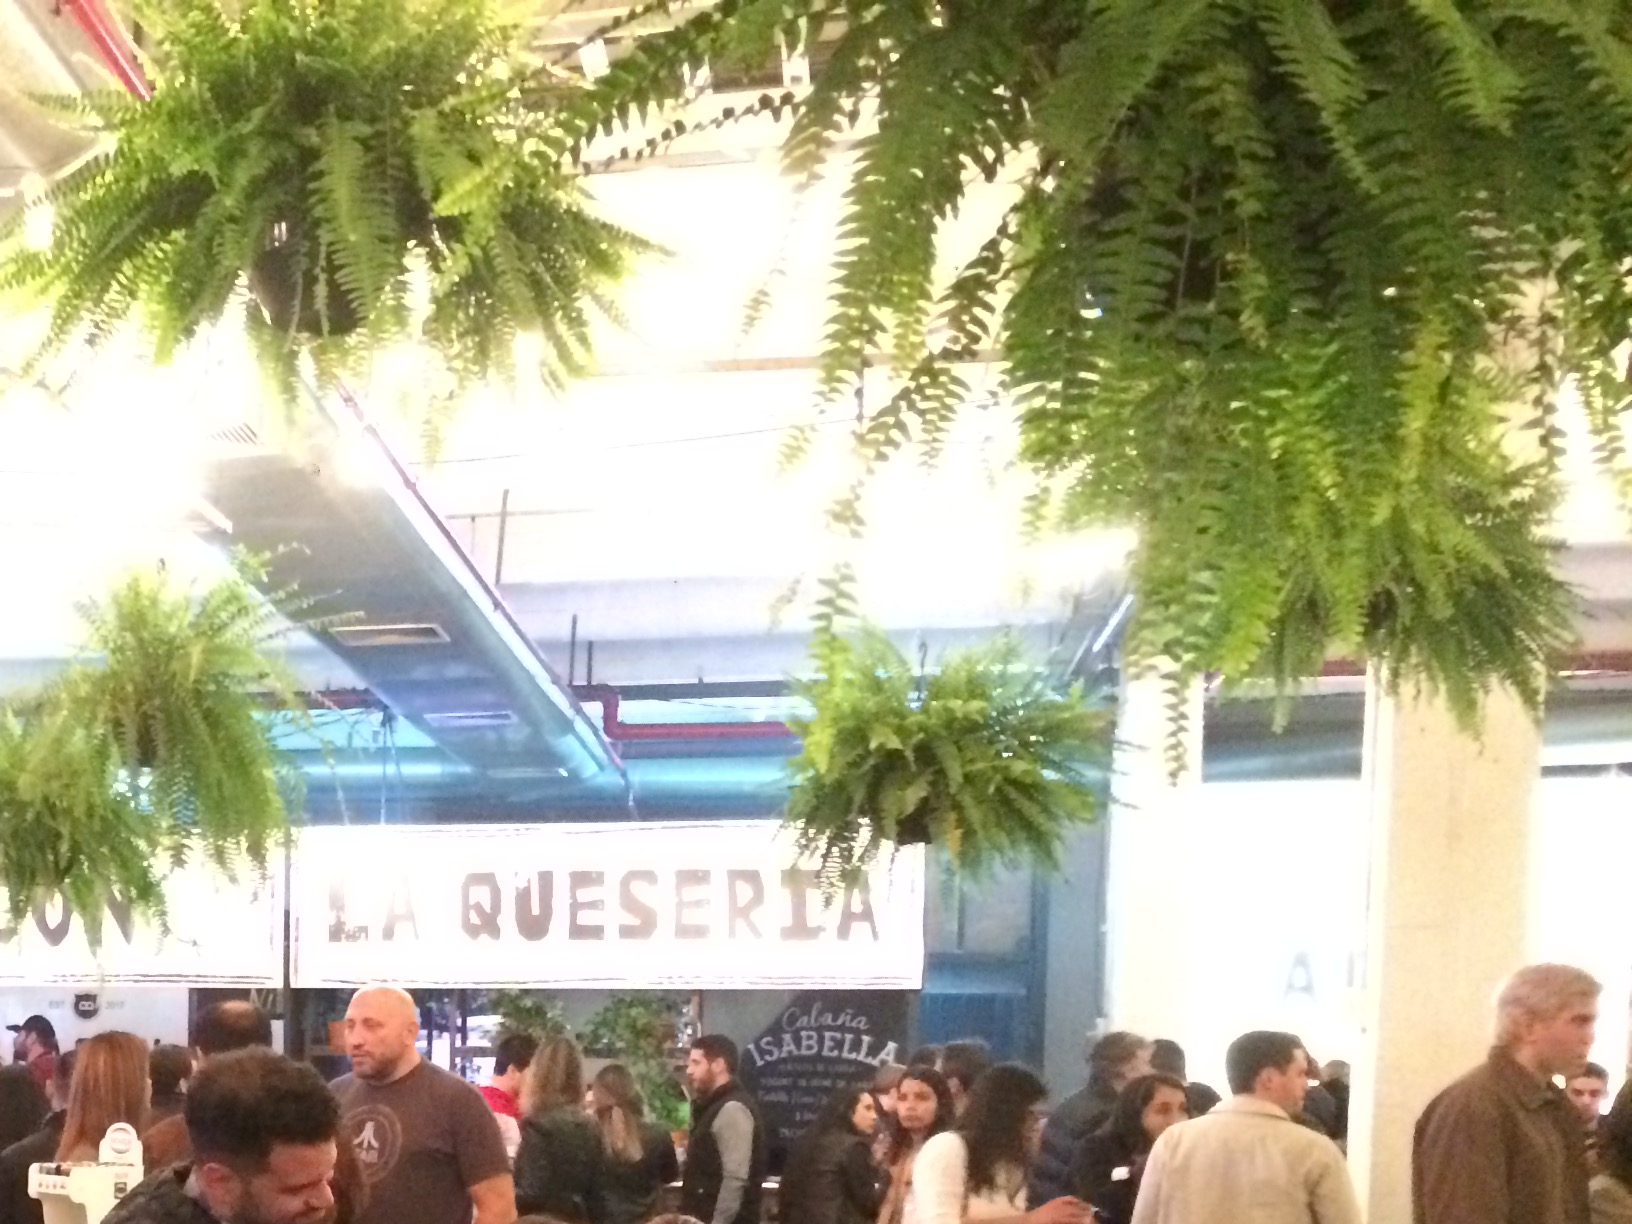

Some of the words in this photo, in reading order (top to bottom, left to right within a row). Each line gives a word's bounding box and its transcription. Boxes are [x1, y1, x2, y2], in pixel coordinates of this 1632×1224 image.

[327, 870, 420, 942] LA
[782, 1002, 870, 1031] Cabaña
[746, 1030, 907, 1068] ISABELLA
